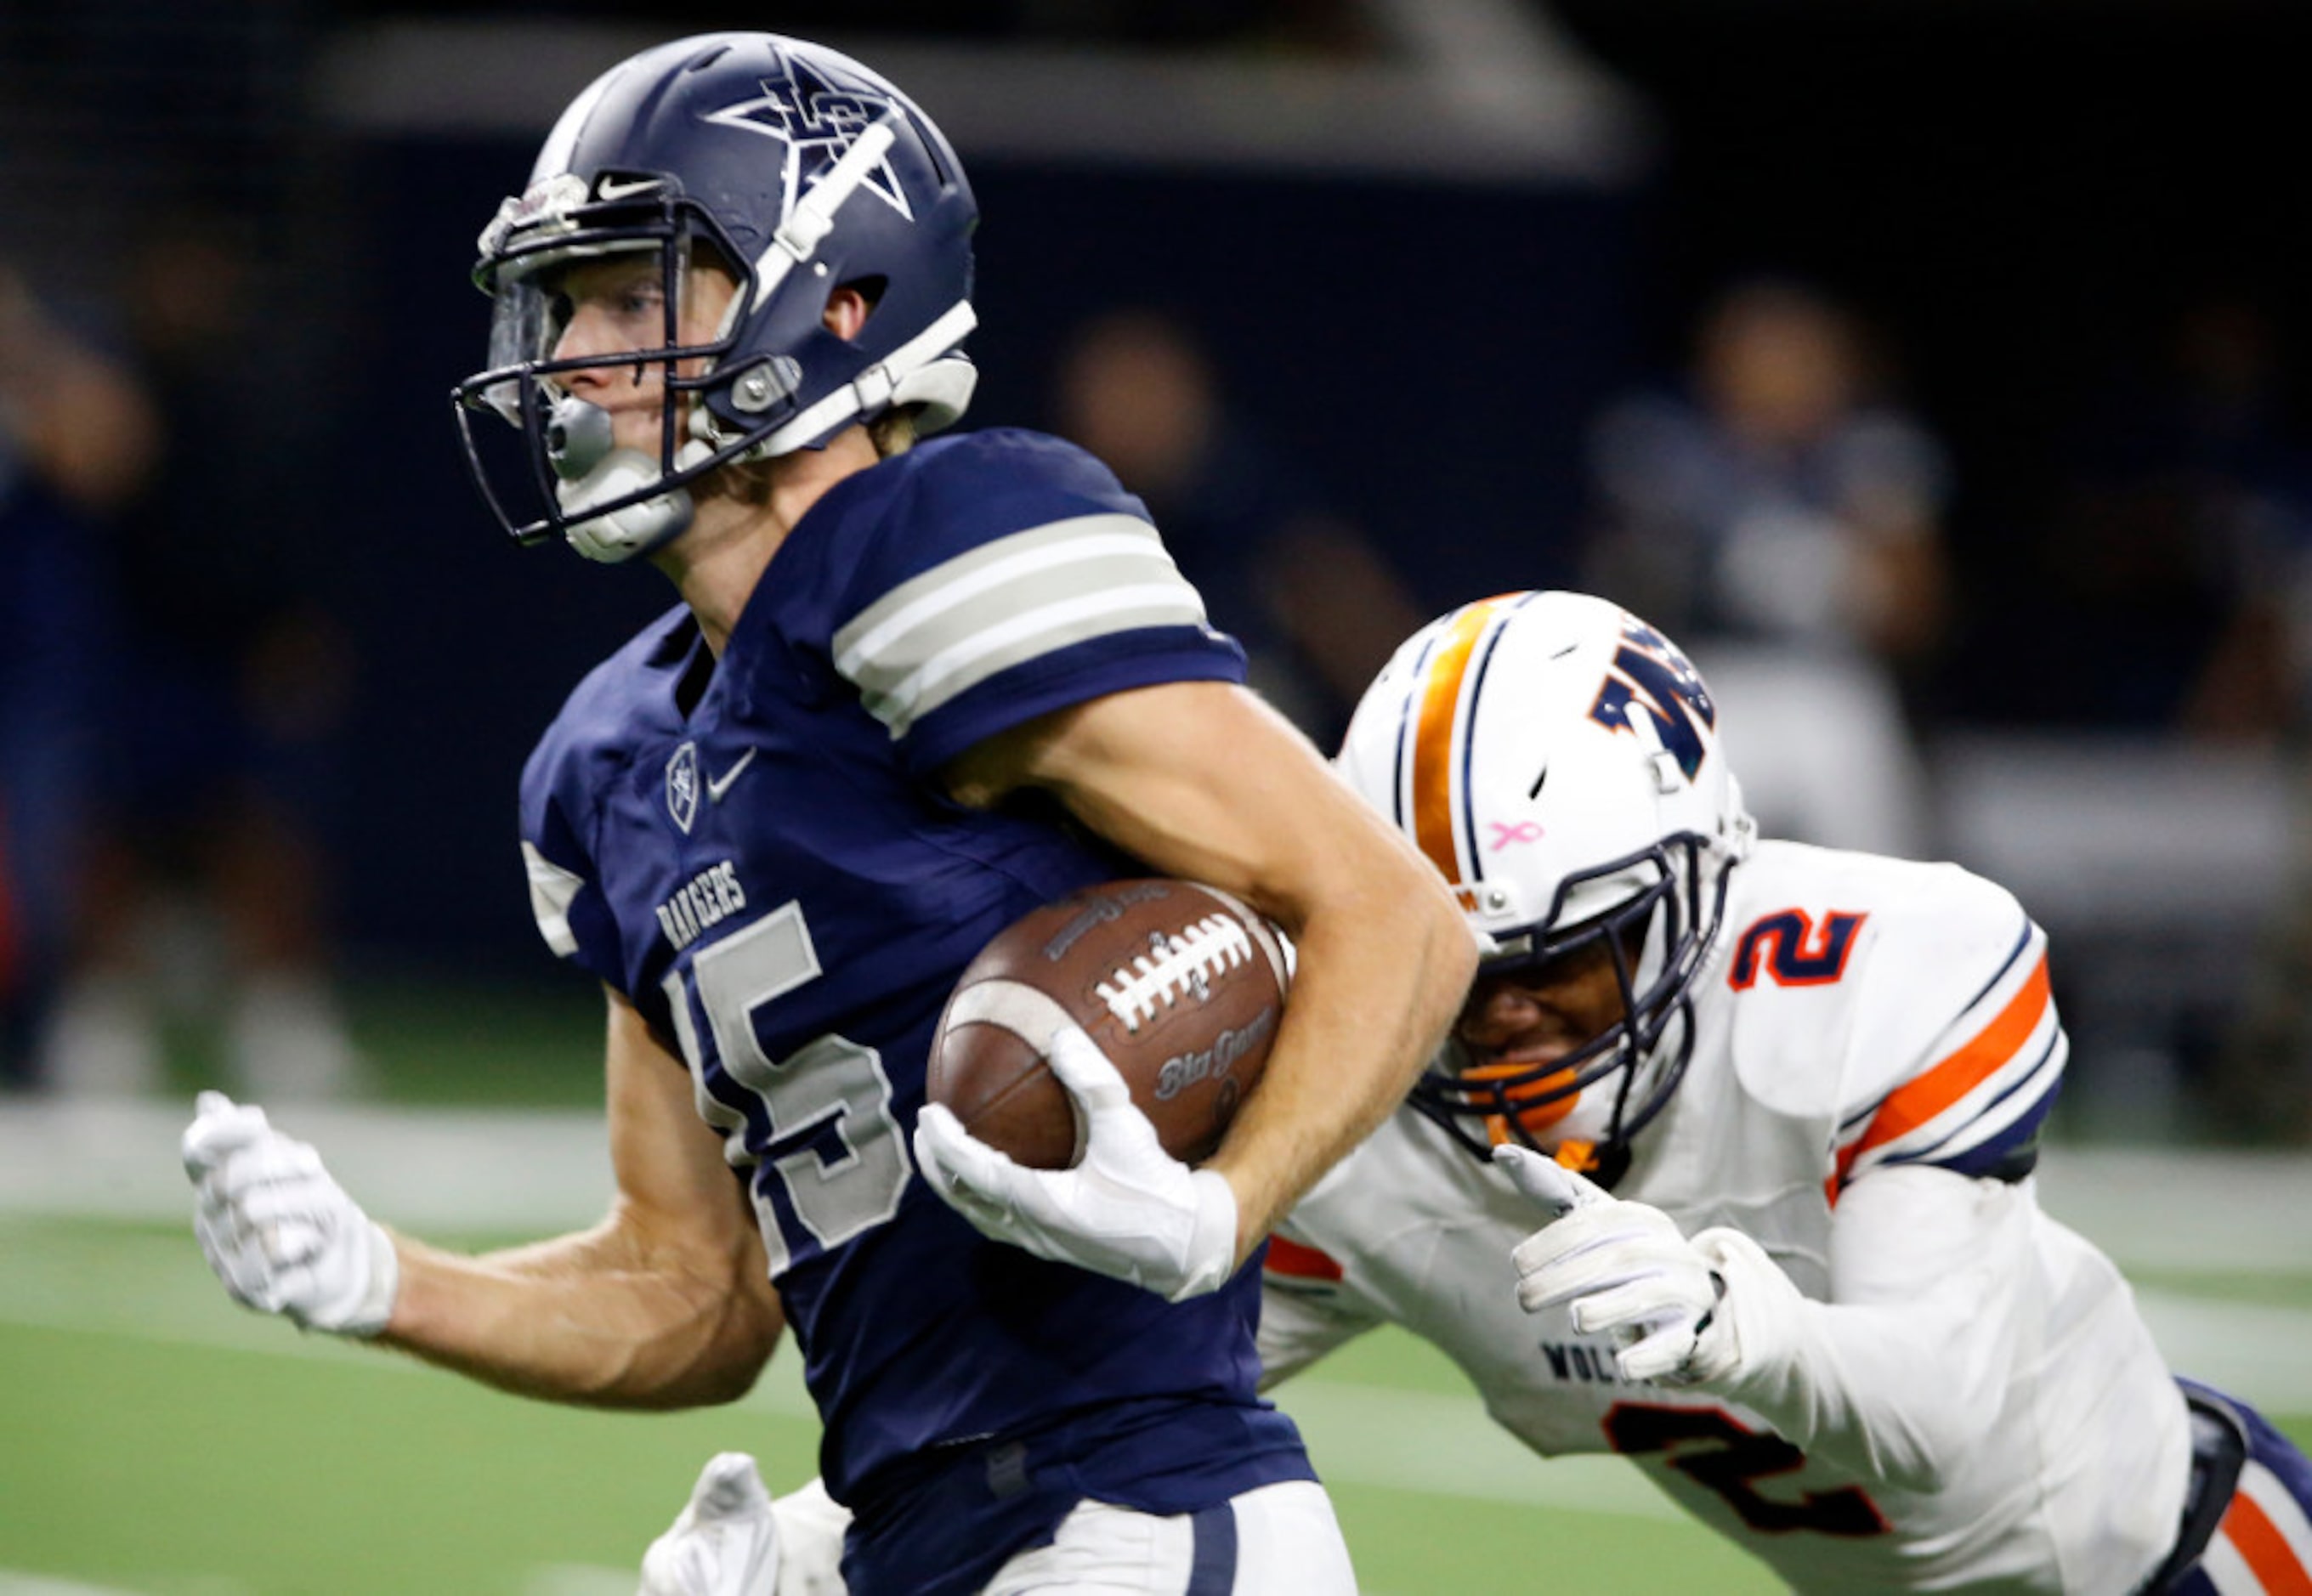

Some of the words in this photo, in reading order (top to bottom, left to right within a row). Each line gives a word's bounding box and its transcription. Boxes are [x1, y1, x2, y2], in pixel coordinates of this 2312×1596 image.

[656, 860, 746, 953] RANGERS
[1726, 907, 1871, 993] 2
[661, 898, 914, 1280] 15
[1601, 1400, 1895, 1537] 2
